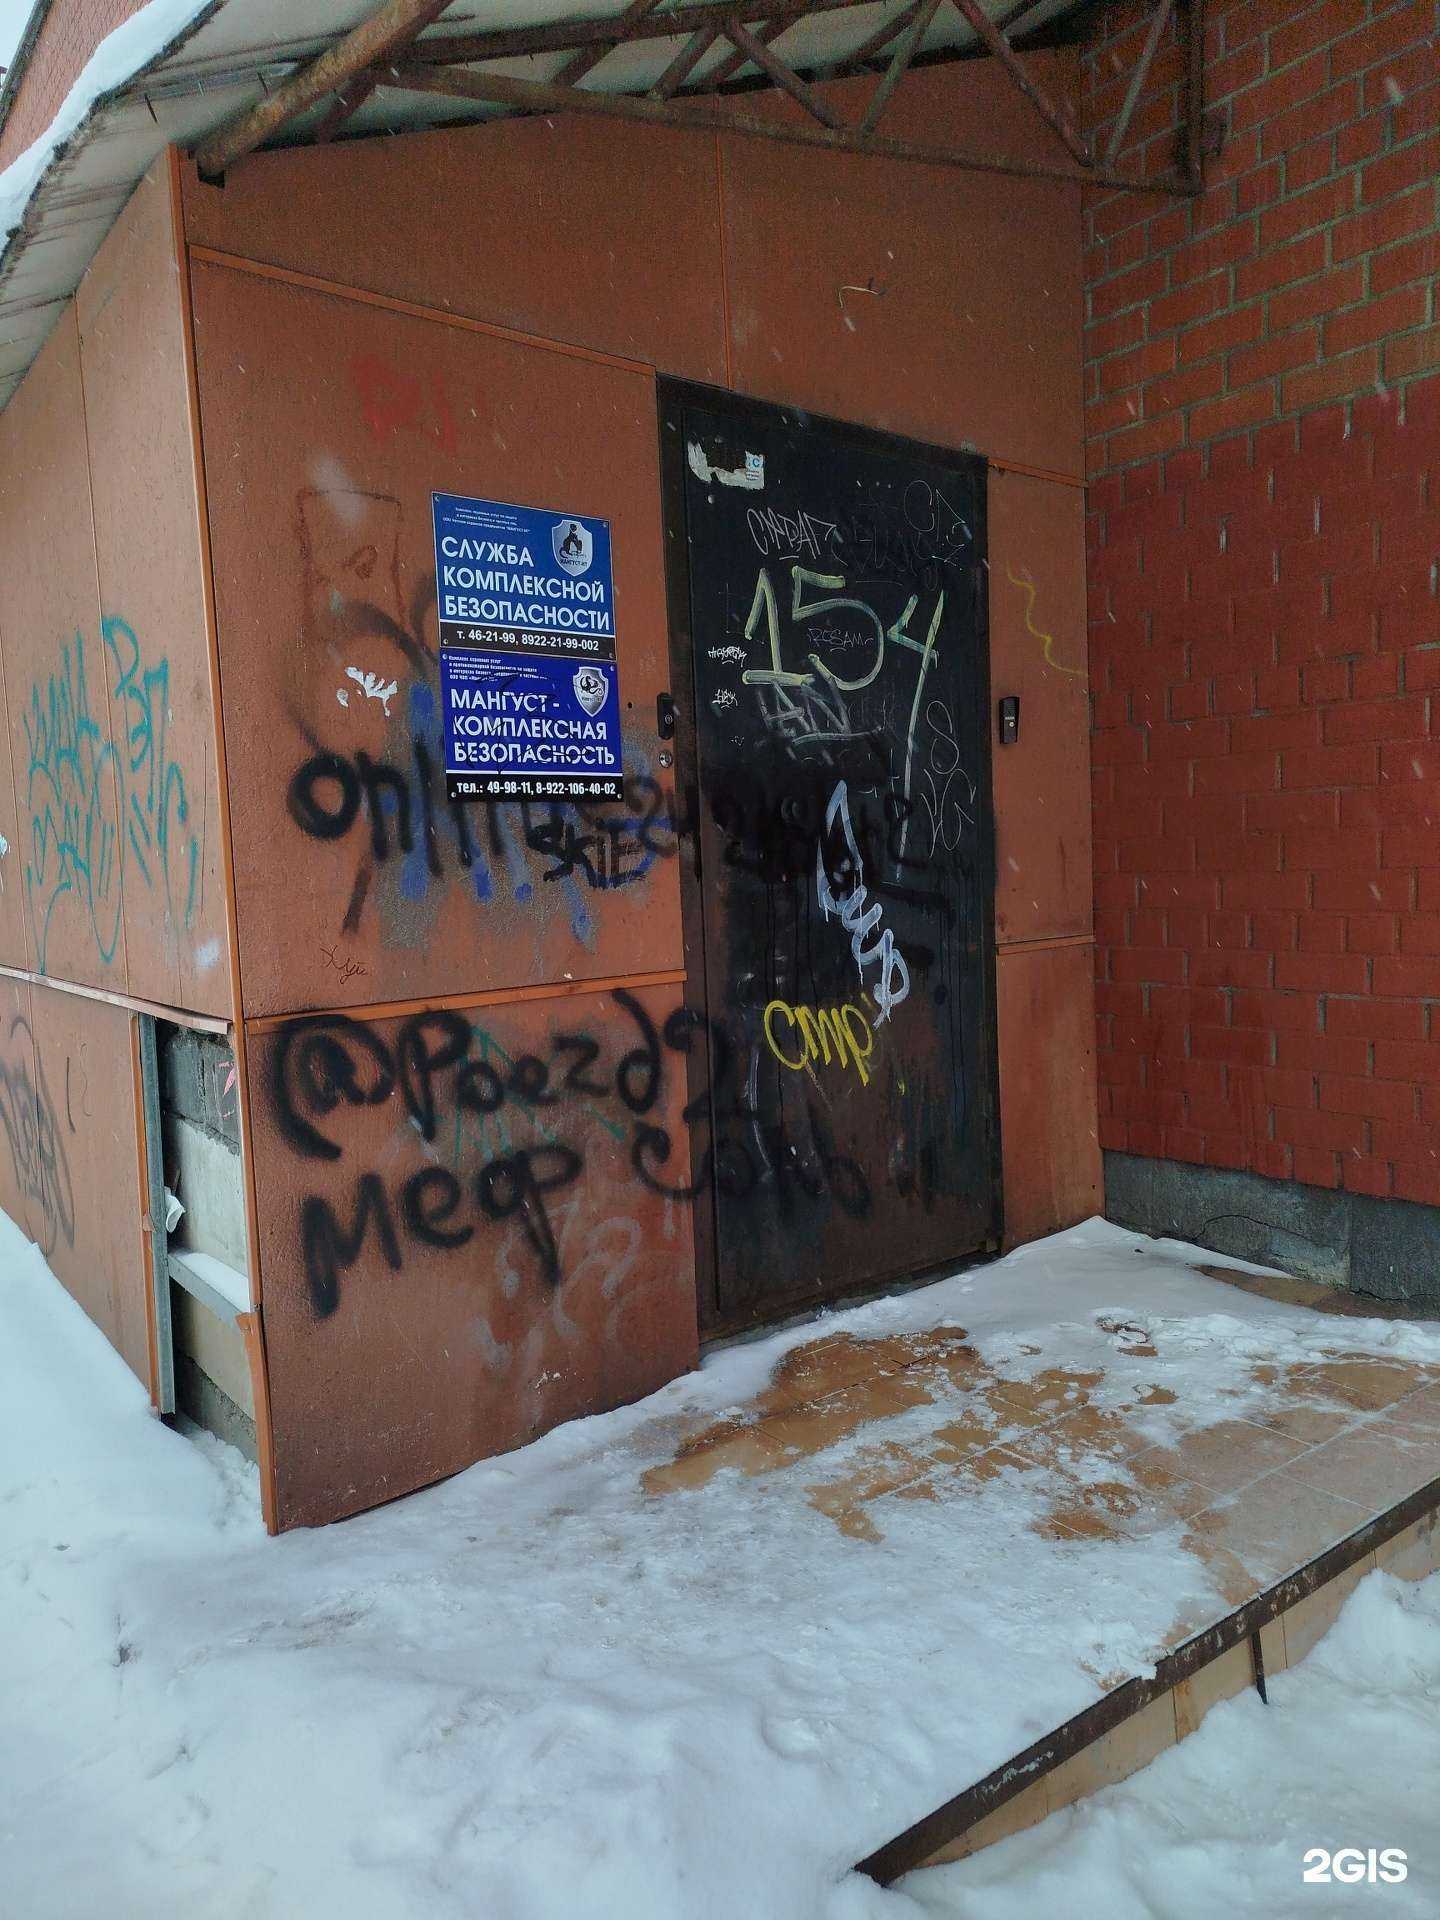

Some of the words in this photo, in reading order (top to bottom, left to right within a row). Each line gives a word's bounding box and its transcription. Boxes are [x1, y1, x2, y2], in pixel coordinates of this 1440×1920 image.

[441, 536, 534, 567] СЛУЖБА
[443, 565, 604, 604] КОМПЛЕКСНОЙ
[445, 594, 610, 631] БЕЗОПАСНОСТИ
[468, 629, 518, 645] 46-21-99,
[521, 633, 599, 651] 8922-21-99-002
[451, 688, 548, 713] МАНГУСТ
[452, 715, 607, 740] КОМПЛЕКСНАЯ
[453, 741, 615, 765] БЕЗОПАСНОСТЬ
[456, 782, 483, 793] тел.:
[487, 781, 534, 795] 49-98-11,
[536, 782, 616, 795] 8-922-106-40-02
